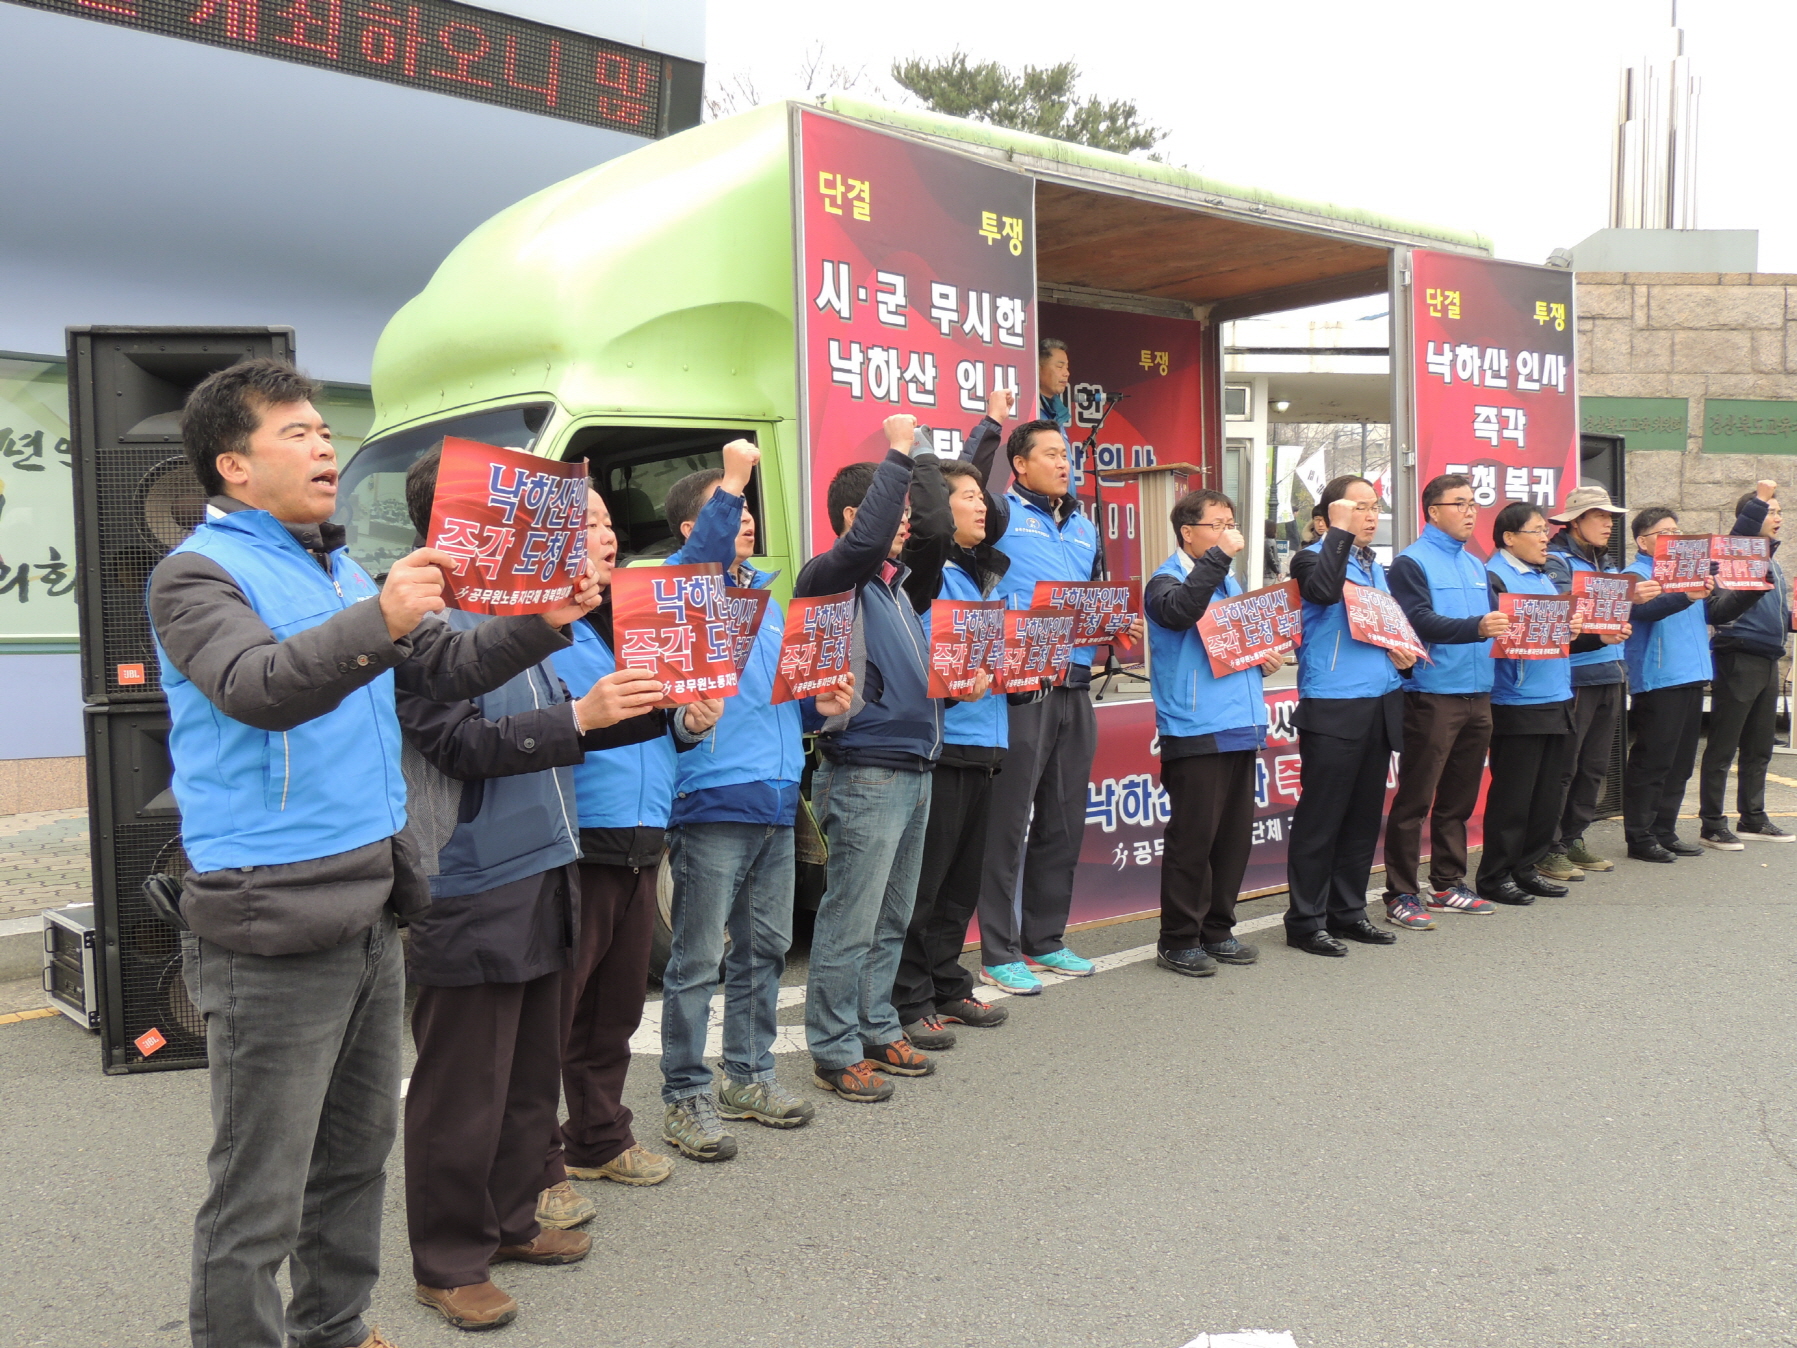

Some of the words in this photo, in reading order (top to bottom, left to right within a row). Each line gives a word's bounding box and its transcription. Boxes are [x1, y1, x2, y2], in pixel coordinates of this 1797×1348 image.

[819, 171, 871, 222] 단결
[979, 211, 1023, 256] 투쟁
[930, 280, 1026, 348] 무시한
[1425, 288, 1461, 319] 단결
[1533, 300, 1566, 331] 투쟁
[828, 337, 937, 406] 낙하산
[957, 360, 1019, 418] 인사
[1139, 349, 1169, 376] 투쟁
[1425, 341, 1509, 390] 낙하산
[1516, 350, 1567, 393] 인사
[1473, 404, 1527, 448] 즉각
[1709, 413, 1797, 438] 경상북도교육
[1505, 466, 1556, 508] 복귀
[435, 517, 516, 580] 즉각
[512, 531, 570, 582] 도청
[1654, 560, 1677, 580] 즉각
[468, 588, 542, 605] 공무원노동자단체
[1050, 587, 1130, 612] 낙하산인사
[1210, 588, 1290, 630] 낙하산인사
[1513, 599, 1569, 622] 낙하산인사
[1016, 616, 1073, 646] 낙하산인사
[1207, 629, 1242, 659] 즉각
[1243, 619, 1274, 647] 도청
[1276, 609, 1302, 637] 복귀
[1349, 605, 1379, 632] 즉각
[1526, 622, 1551, 645] 도청
[622, 626, 696, 674] 즉각
[781, 642, 816, 679] 즉각
[817, 636, 847, 670] 도청
[933, 643, 967, 675] 즉각
[1025, 646, 1050, 672] 도청
[123, 669, 140, 678] JBL
[141, 1036, 160, 1049] JBL
